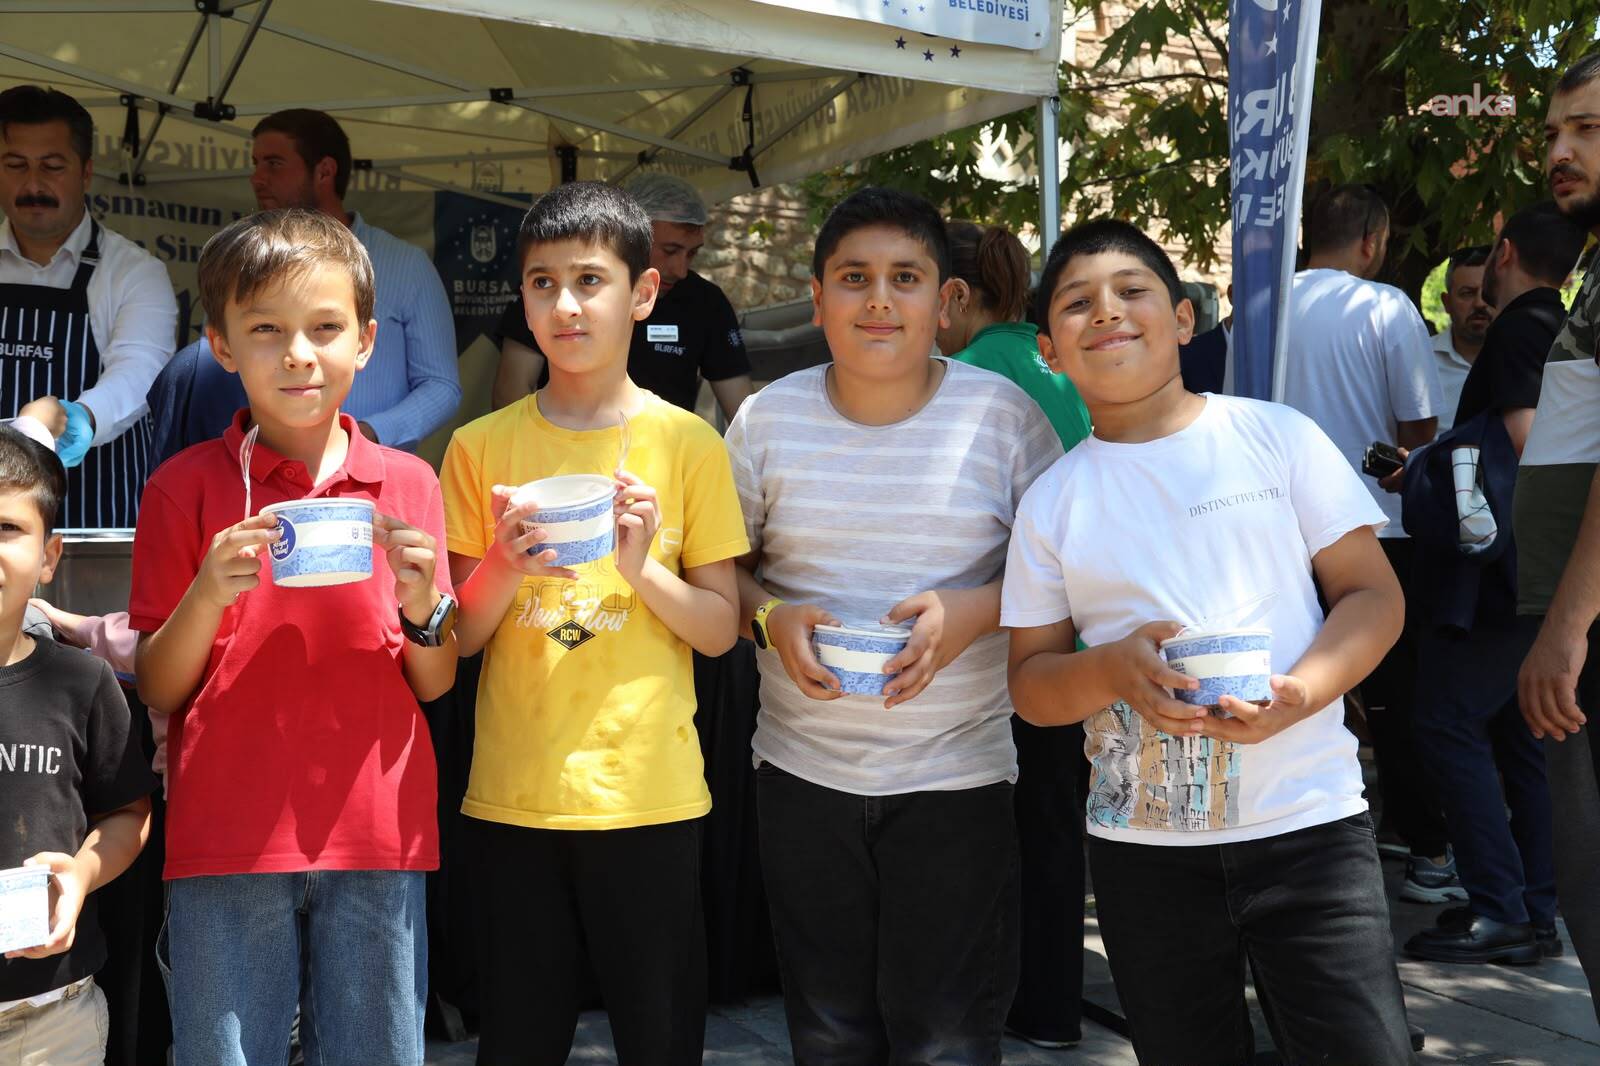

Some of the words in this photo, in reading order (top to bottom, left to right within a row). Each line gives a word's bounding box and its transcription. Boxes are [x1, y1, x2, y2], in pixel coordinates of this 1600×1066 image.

[949, 0, 1029, 22] BELEDİYESİ
[454, 280, 512, 294] BURSA
[1189, 492, 1258, 517] DISTINCTIVE
[560, 628, 582, 642] RCW
